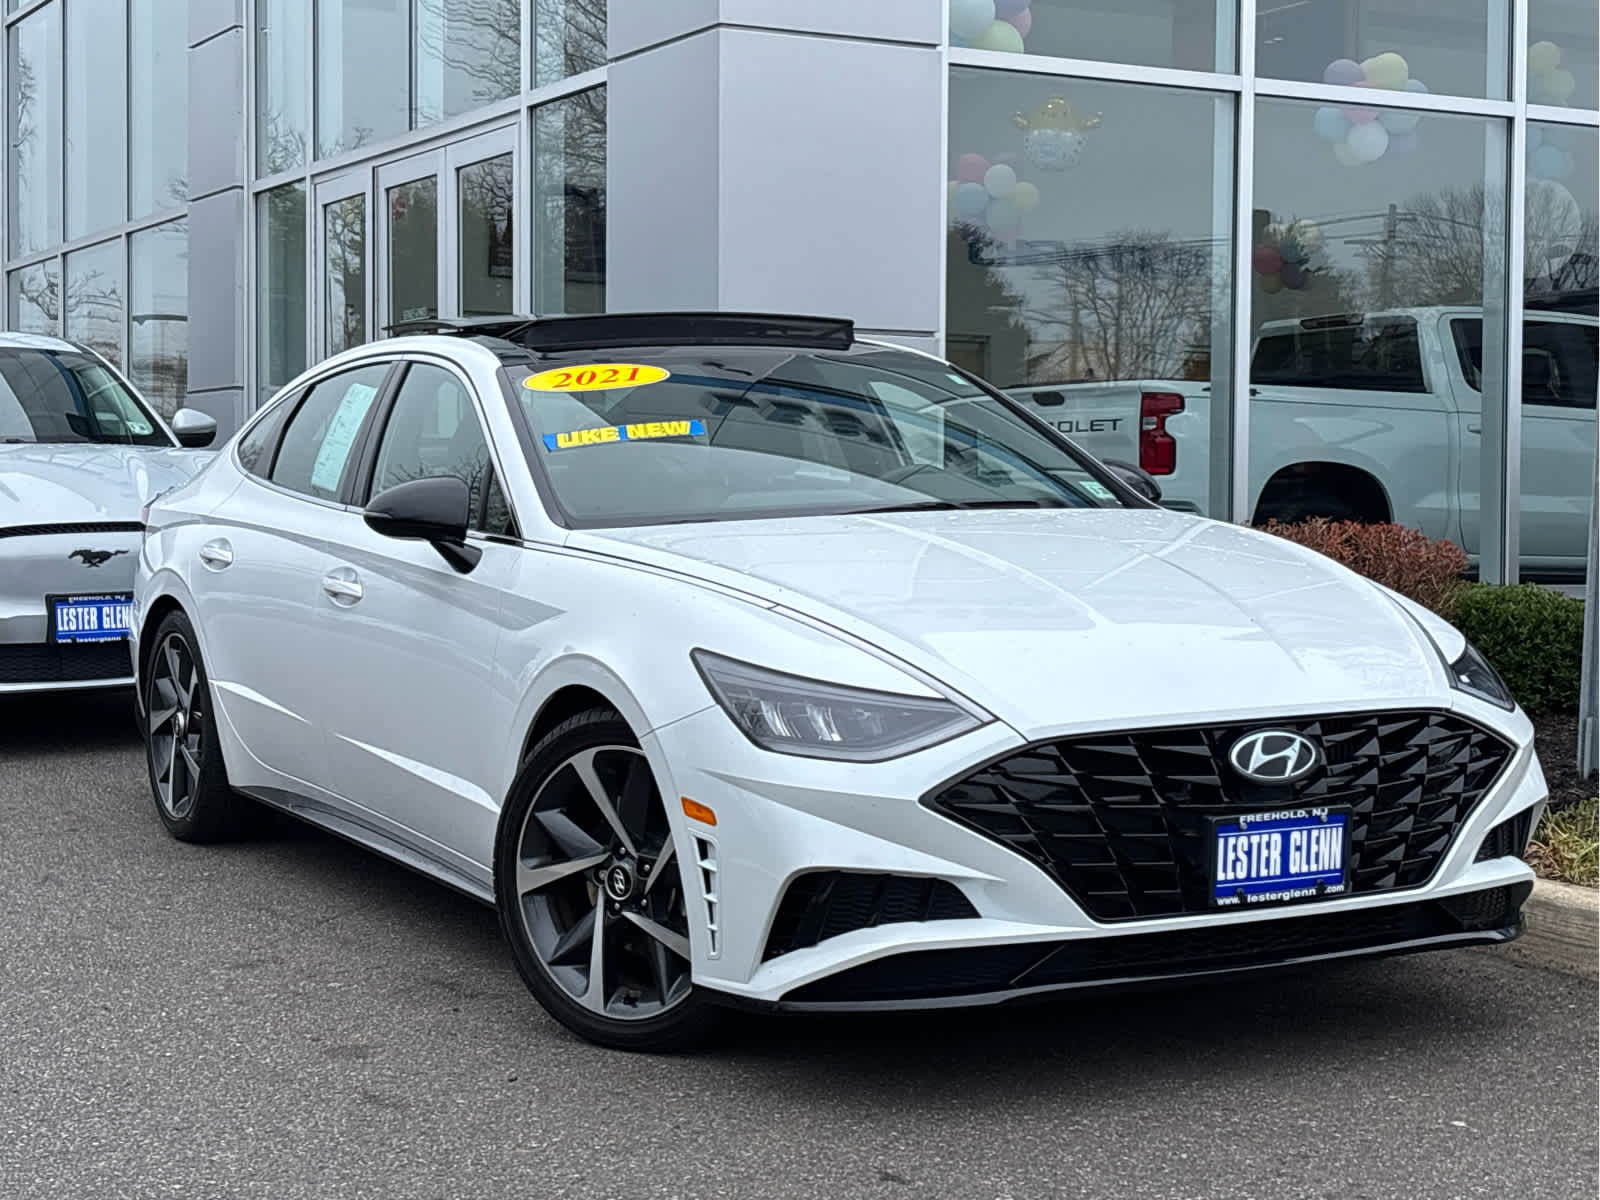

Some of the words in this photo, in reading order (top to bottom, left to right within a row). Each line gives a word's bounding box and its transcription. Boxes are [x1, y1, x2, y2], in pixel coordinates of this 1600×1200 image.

[552, 367, 640, 389] 2021
[556, 426, 621, 449] LIKE
[625, 420, 691, 440] NEW
[1048, 418, 1123, 433] OLET
[57, 607, 97, 631] LESTER
[1216, 833, 1282, 881] LESTER
[1289, 827, 1343, 875] GLENN
[1247, 888, 1316, 903] lesterglenn
